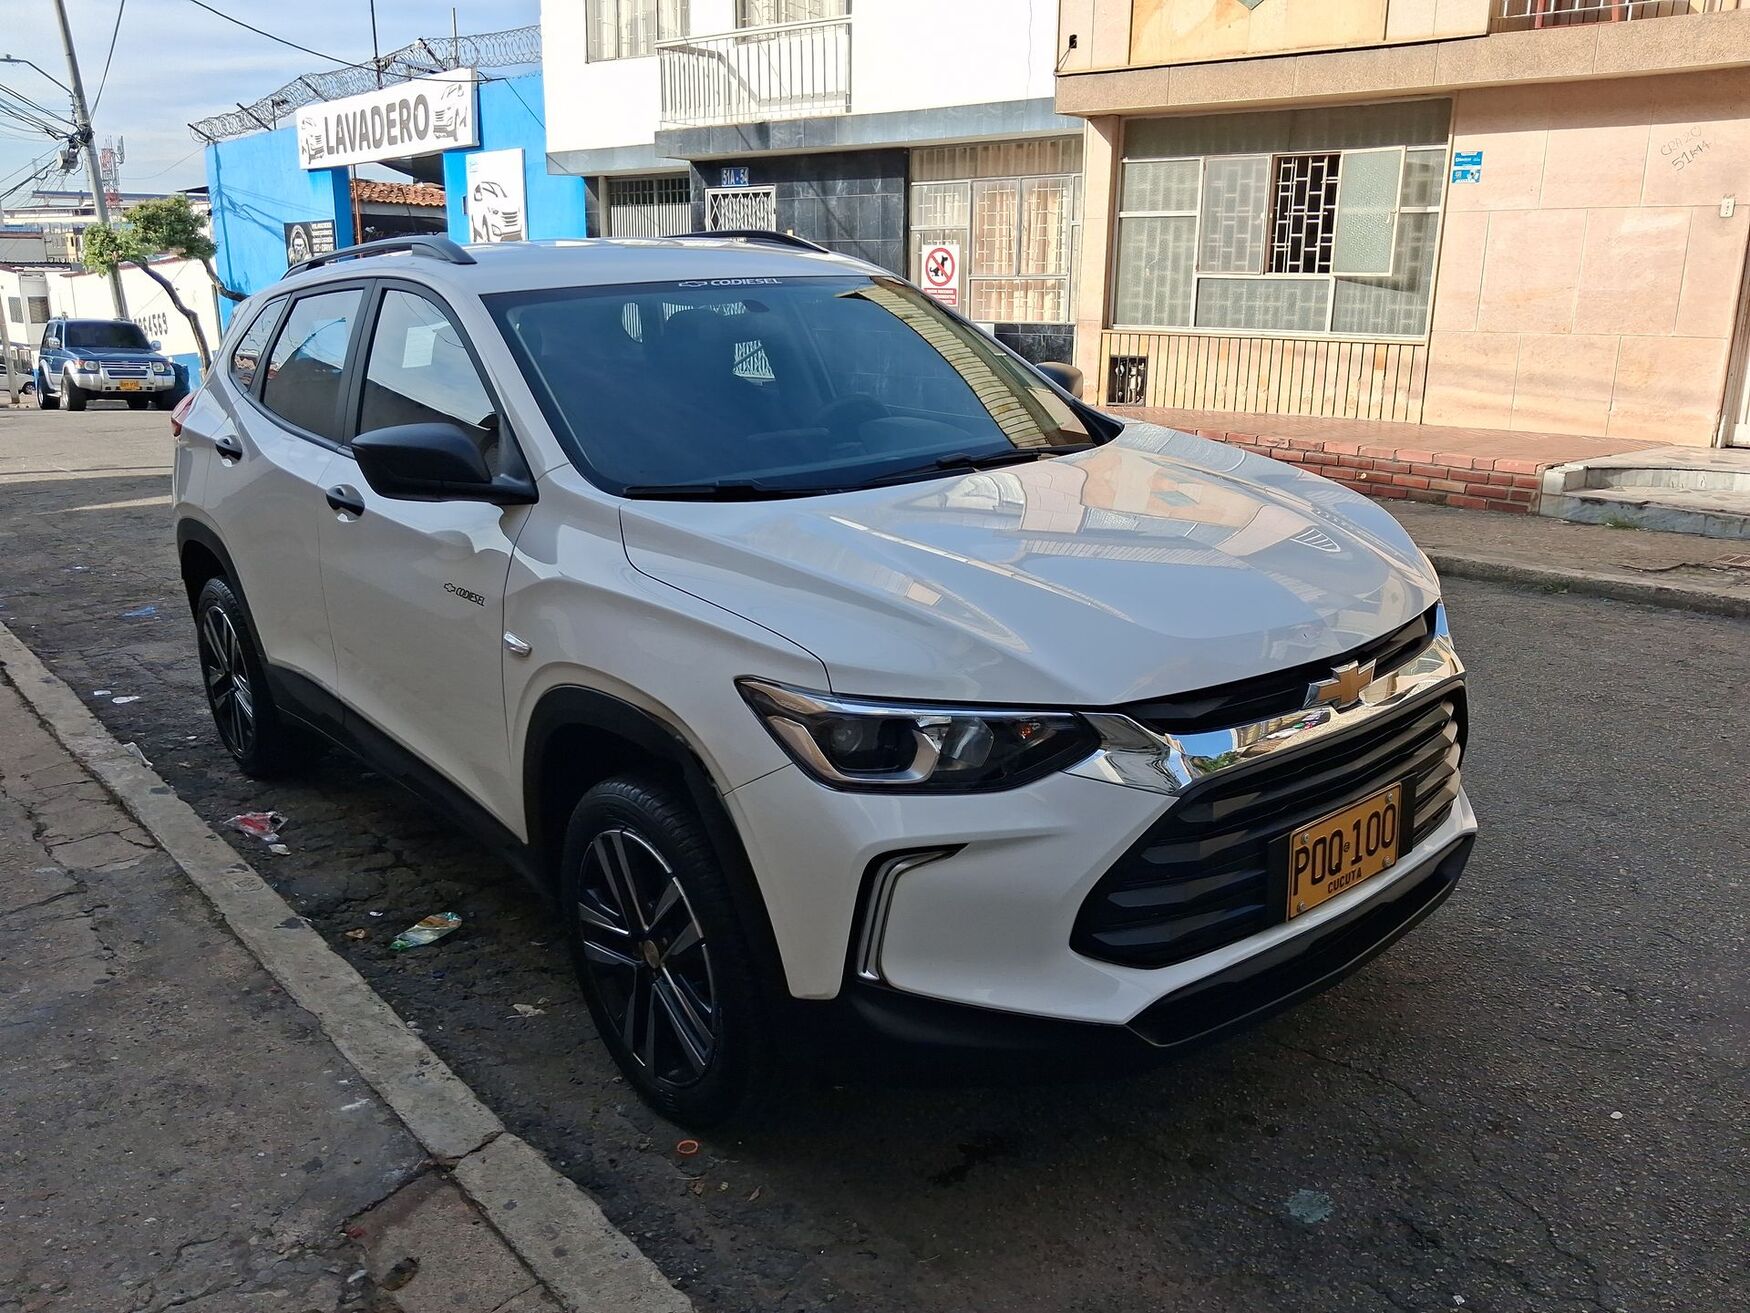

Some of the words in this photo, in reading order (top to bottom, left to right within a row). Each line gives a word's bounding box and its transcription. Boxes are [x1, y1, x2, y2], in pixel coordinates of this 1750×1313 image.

[324, 93, 430, 156] LAVADERO
[710, 277, 783, 287] CODIESEL
[455, 587, 485, 607] CODIESEL
[1350, 803, 1396, 866] 100
[1327, 867, 1362, 894] CUCUTA
